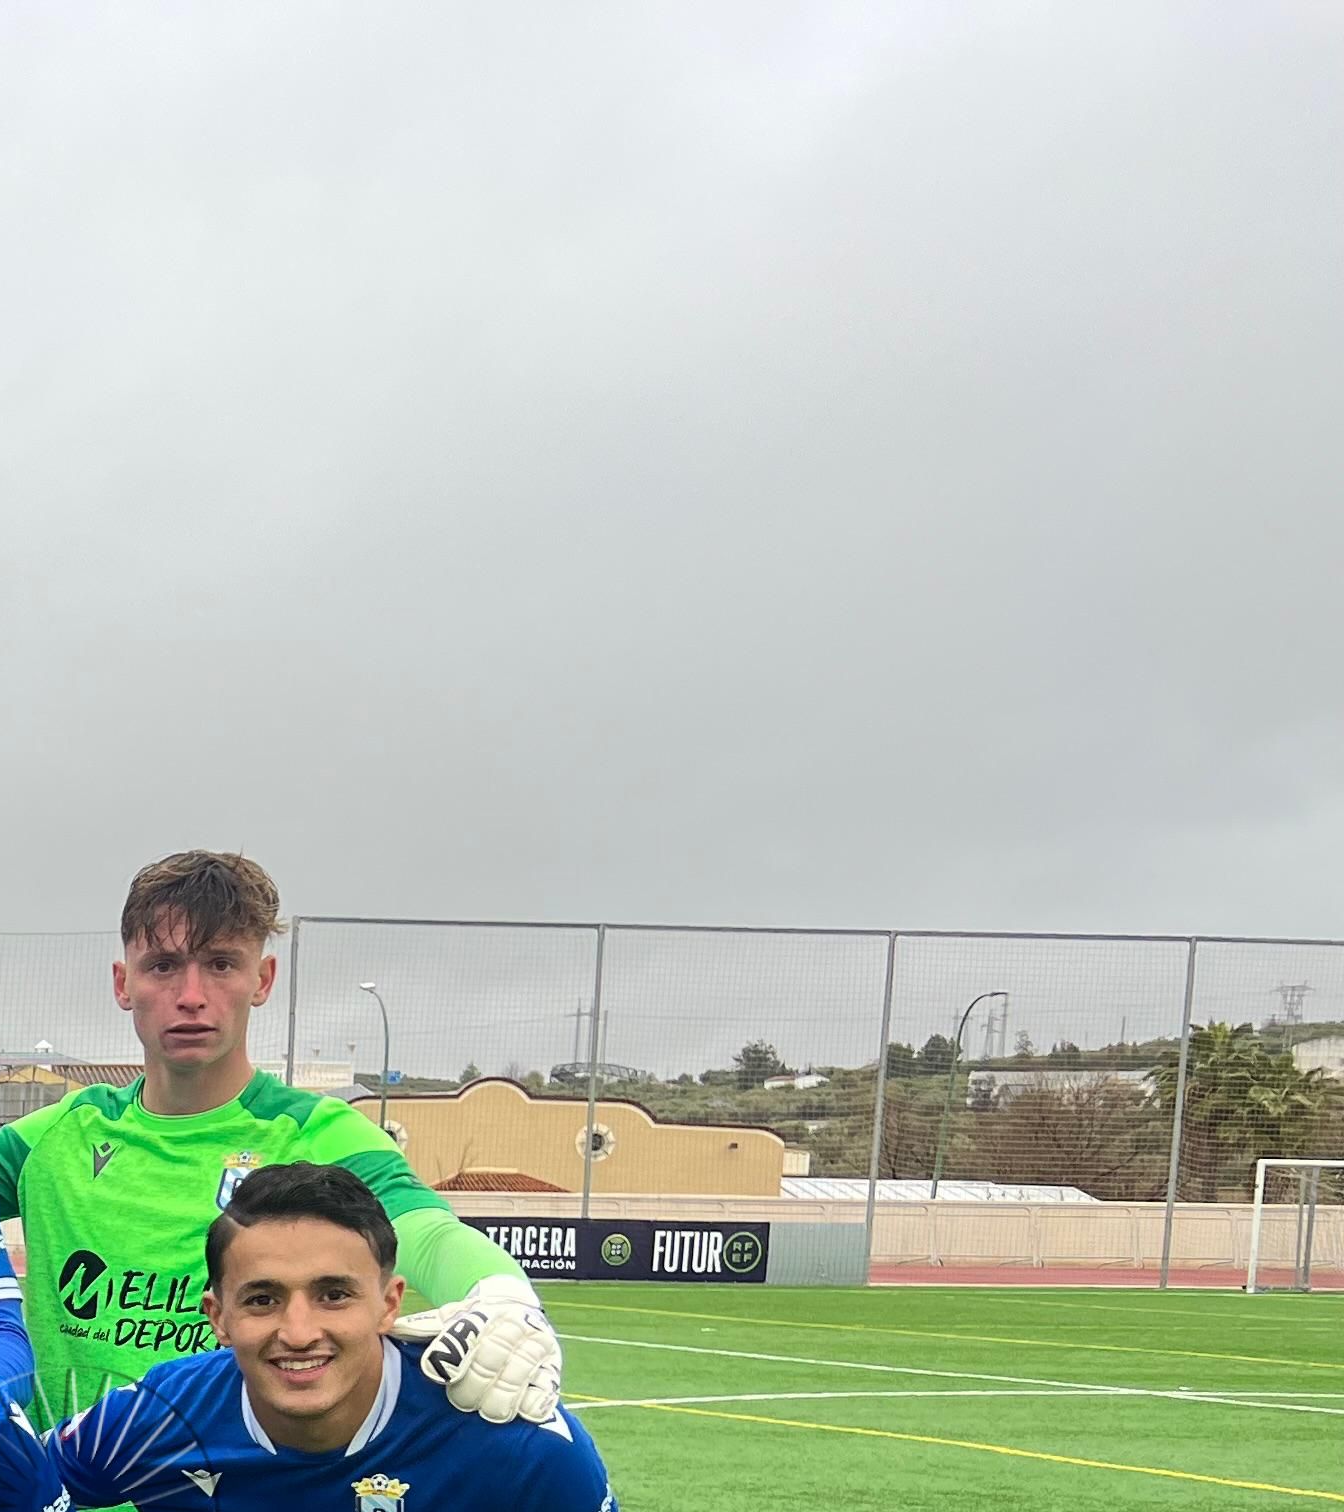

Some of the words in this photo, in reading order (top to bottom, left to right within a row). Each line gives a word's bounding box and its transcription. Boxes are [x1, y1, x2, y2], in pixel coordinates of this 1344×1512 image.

[486, 1226, 576, 1257] TERCERA
[516, 1258, 576, 1270] RACIÓN
[58, 1249, 210, 1320] MELIL
[93, 1327, 111, 1342] del
[114, 1318, 220, 1354] DEPOR
